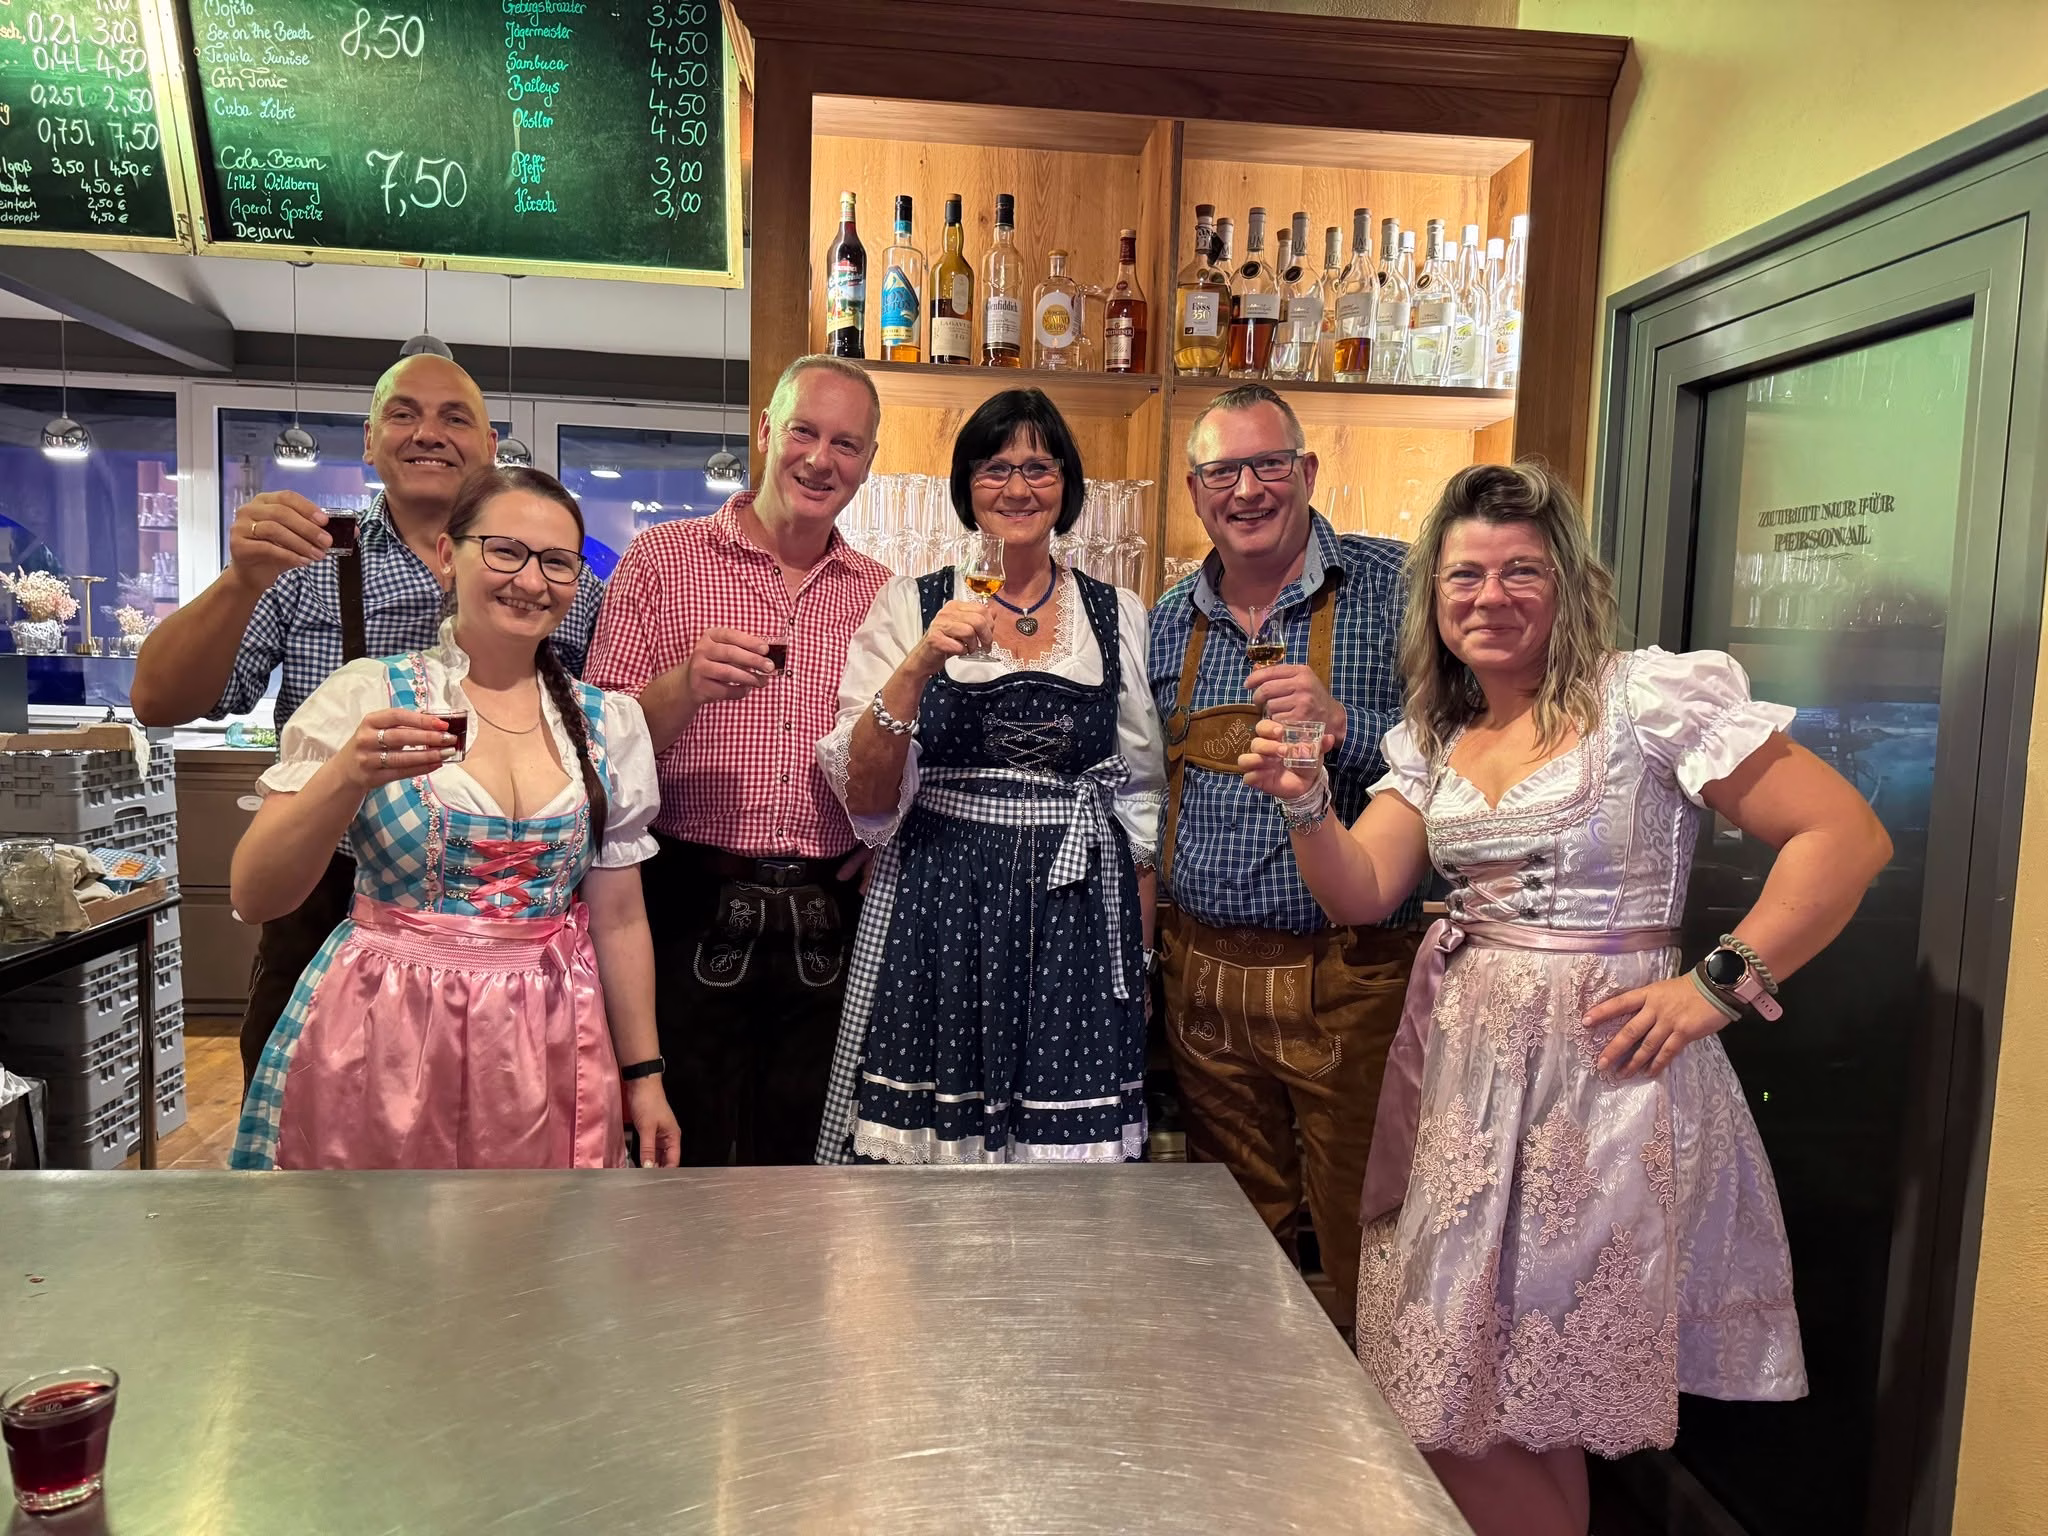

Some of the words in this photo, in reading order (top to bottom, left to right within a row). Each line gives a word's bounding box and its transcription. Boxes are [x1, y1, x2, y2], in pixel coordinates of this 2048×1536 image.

[207, 23, 229, 41] Sex
[233, 29, 250, 40] on
[251, 22, 273, 39] the
[274, 21, 314, 41] Beach
[647, 4, 707, 29] 3,50
[340, 8, 425, 60] 8,50
[650, 28, 709, 55] 4,50
[96, 48, 147, 80] 4,50
[203, 42, 252, 71] Tequila
[262, 46, 310, 65] Sunrise
[506, 51, 569, 71] Sambuca
[651, 57, 708, 89] 4,50
[211, 67, 244, 91] Gin
[240, 67, 288, 88] Tonic
[103, 85, 153, 117] 2,50
[214, 97, 252, 117] Cuba
[508, 75, 560, 107] Baileys
[649, 88, 706, 118] 4,50
[107, 122, 159, 152] 7,50
[651, 116, 708, 146] 4,50
[51, 157, 85, 177] 3,50
[109, 160, 139, 178] 4,50
[221, 146, 266, 169] Cola
[267, 149, 326, 170] Beam
[80, 178, 111, 194] 4,50
[366, 150, 467, 217] 7,50
[651, 157, 702, 189] 3,00
[264, 172, 320, 205] Wildberry
[514, 187, 557, 213] Kirsch
[653, 189, 701, 218] 3,00
[0, 211, 41, 224] doppelt
[90, 211, 116, 224] 4,50
[87, 197, 113, 211] 2,50
[230, 198, 272, 221] Aperol
[280, 198, 323, 229] Spritz
[986, 299, 1018, 313] Genfiddich
[1758, 504, 1821, 528] ZUTRITT
[1821, 499, 1857, 521] NUR
[1858, 492, 1896, 516] FÜR
[1773, 524, 1871, 552] PERSONAL
